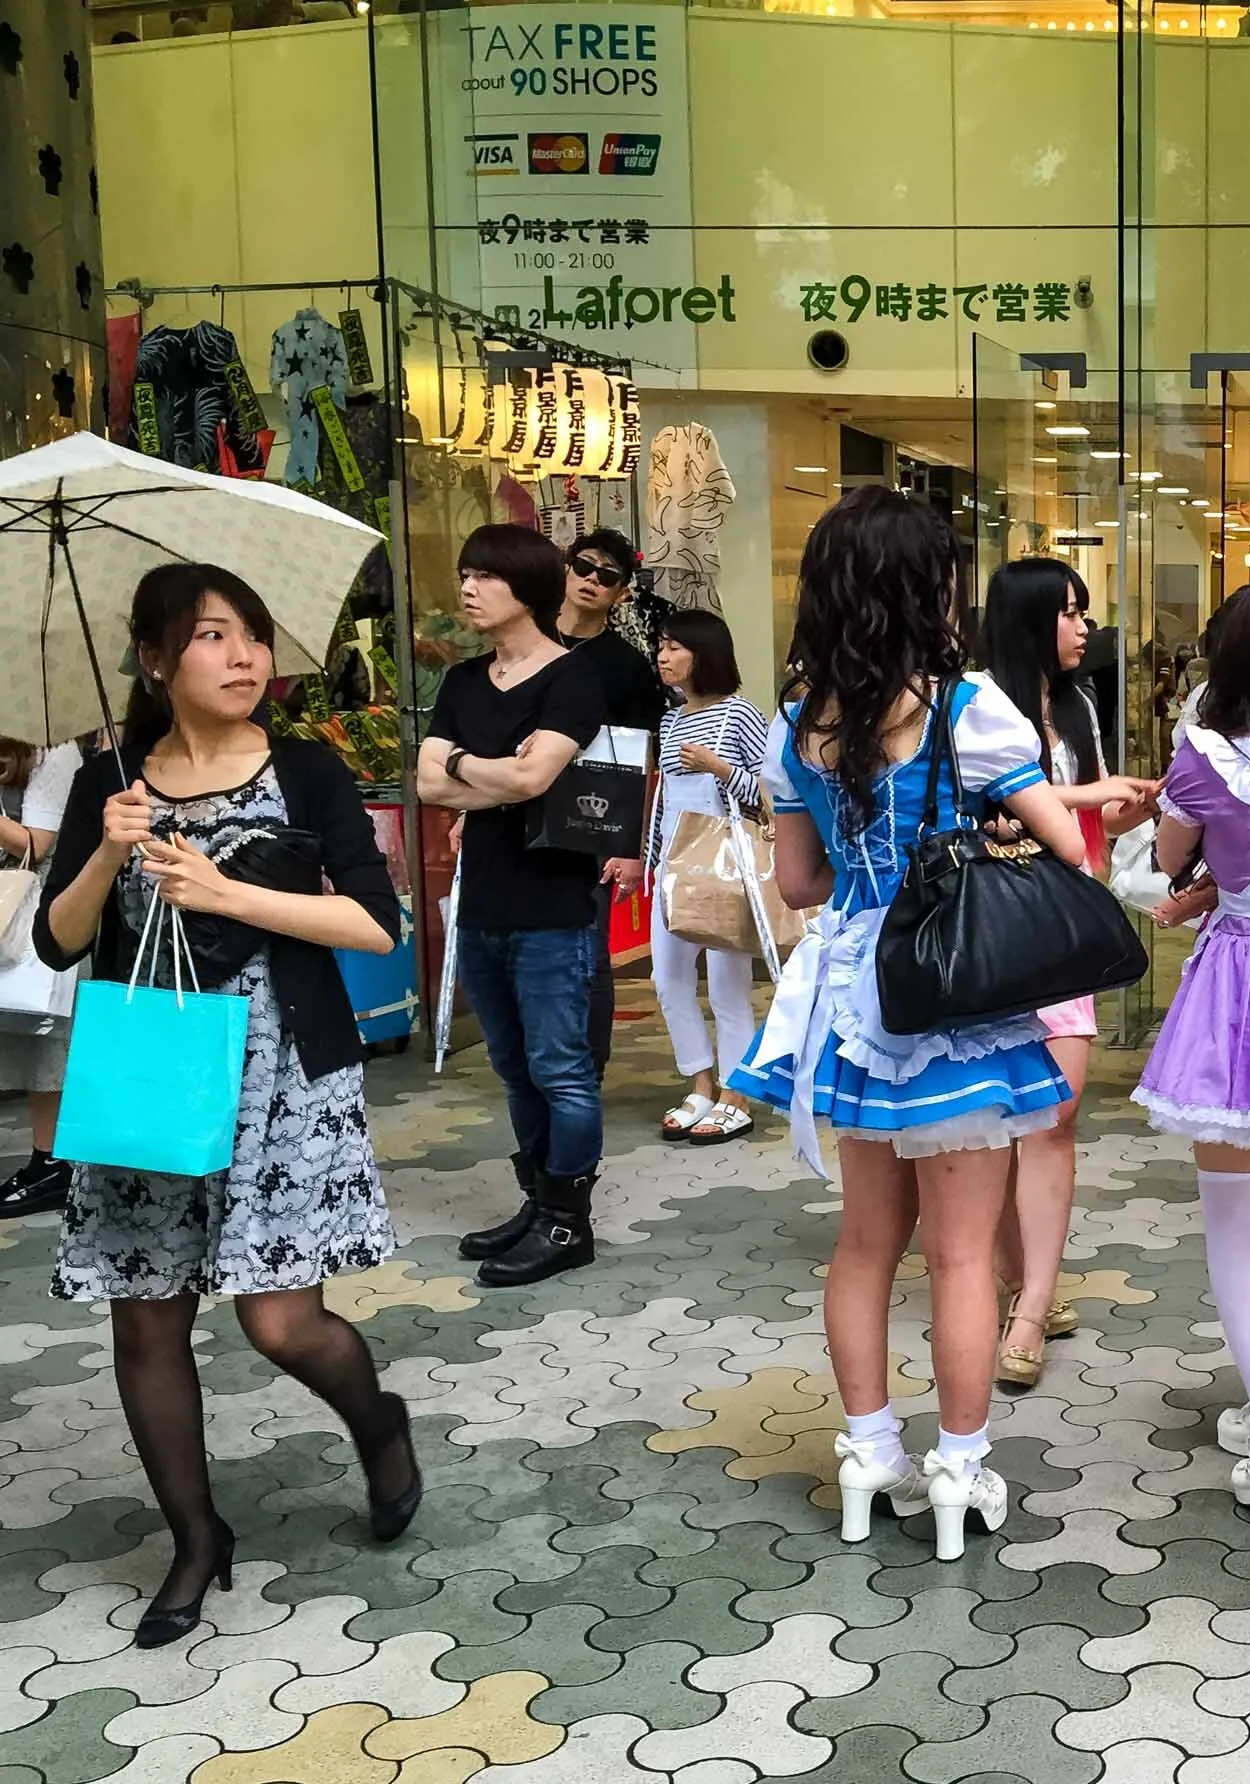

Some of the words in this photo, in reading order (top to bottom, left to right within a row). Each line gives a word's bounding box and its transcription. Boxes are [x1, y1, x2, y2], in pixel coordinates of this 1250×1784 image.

[460, 24, 544, 62] TAX
[554, 24, 657, 61] FREE
[510, 67, 547, 96] 90
[553, 67, 658, 97] SHOPS
[474, 146, 513, 164] VISA
[604, 144, 656, 161] UnionPay
[478, 213, 649, 245] 夜9時まで営業
[514, 253, 554, 269] 11:00
[568, 253, 615, 269] 21:00
[544, 274, 737, 323] Laforet
[800, 275, 1071, 322] 夜9時まで営業
